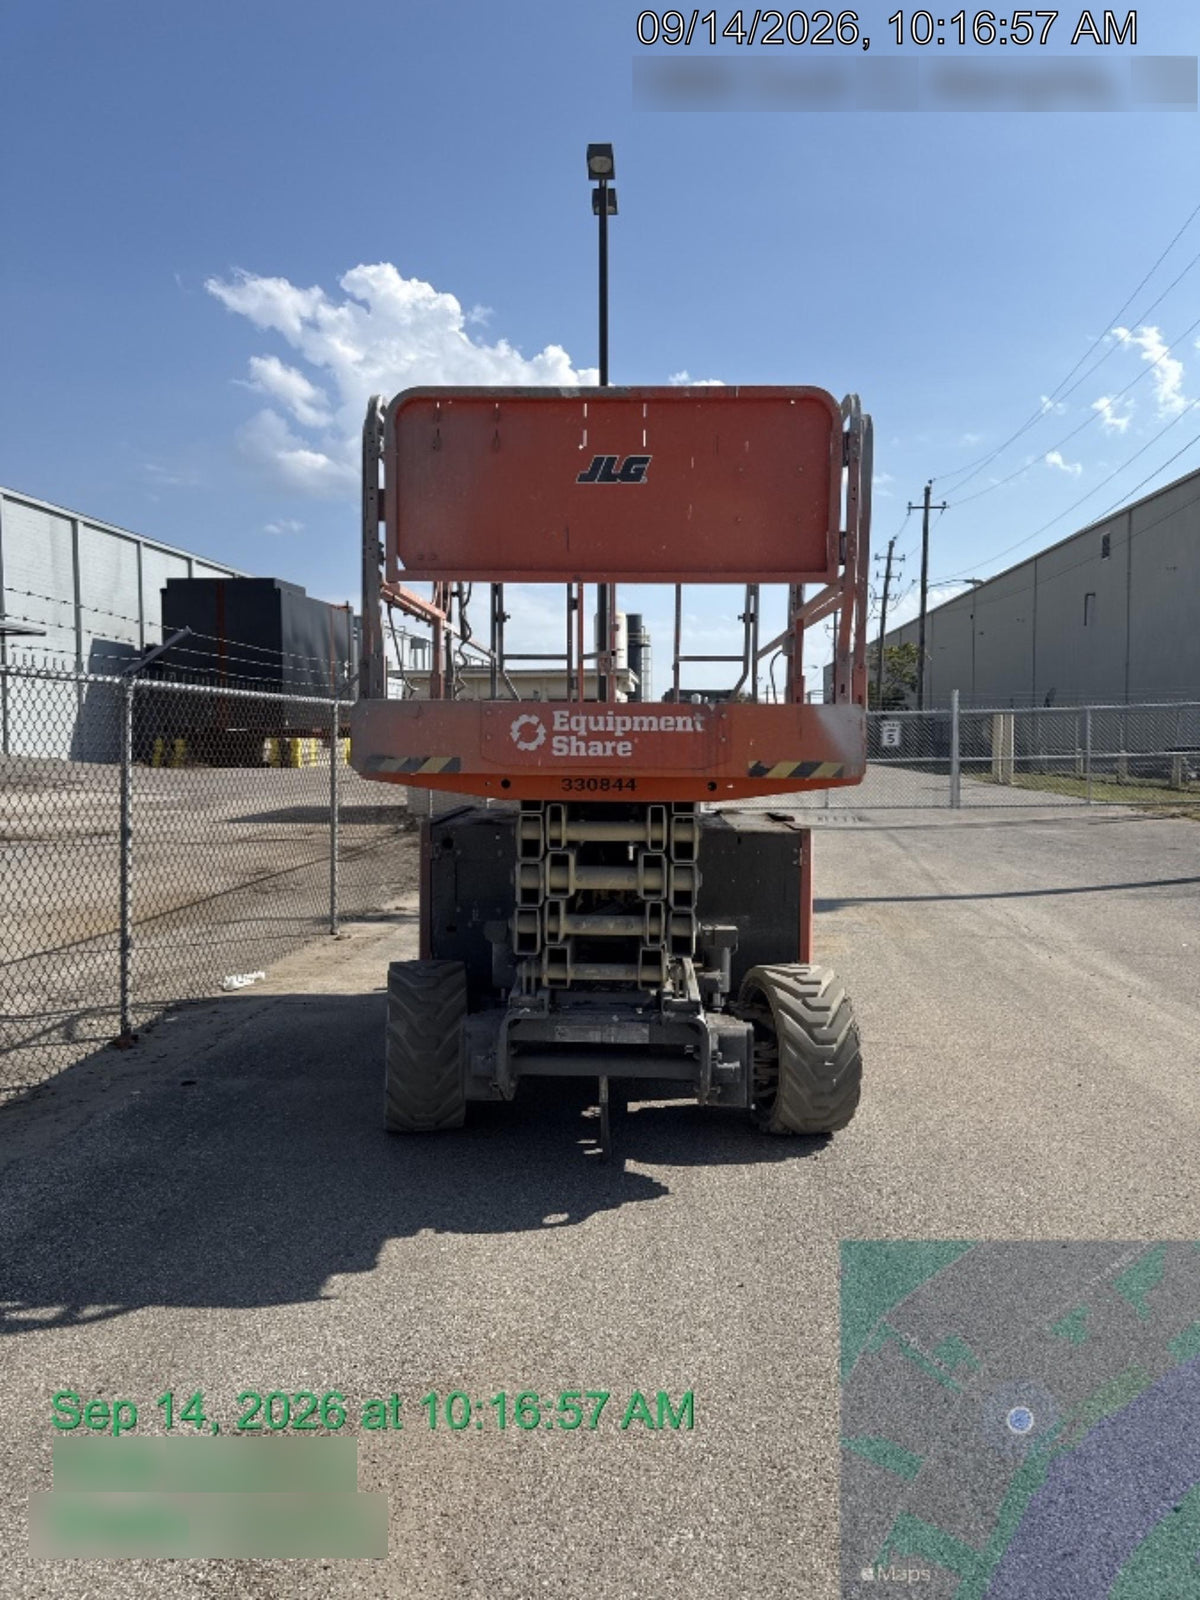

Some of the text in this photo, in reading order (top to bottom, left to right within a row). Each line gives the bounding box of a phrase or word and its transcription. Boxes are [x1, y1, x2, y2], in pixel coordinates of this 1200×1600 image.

[576, 455, 652, 484] JLG
[552, 711, 706, 737] Equipment
[552, 735, 633, 757] Share
[887, 733, 896, 744] 5
[561, 777, 638, 792] 330844
